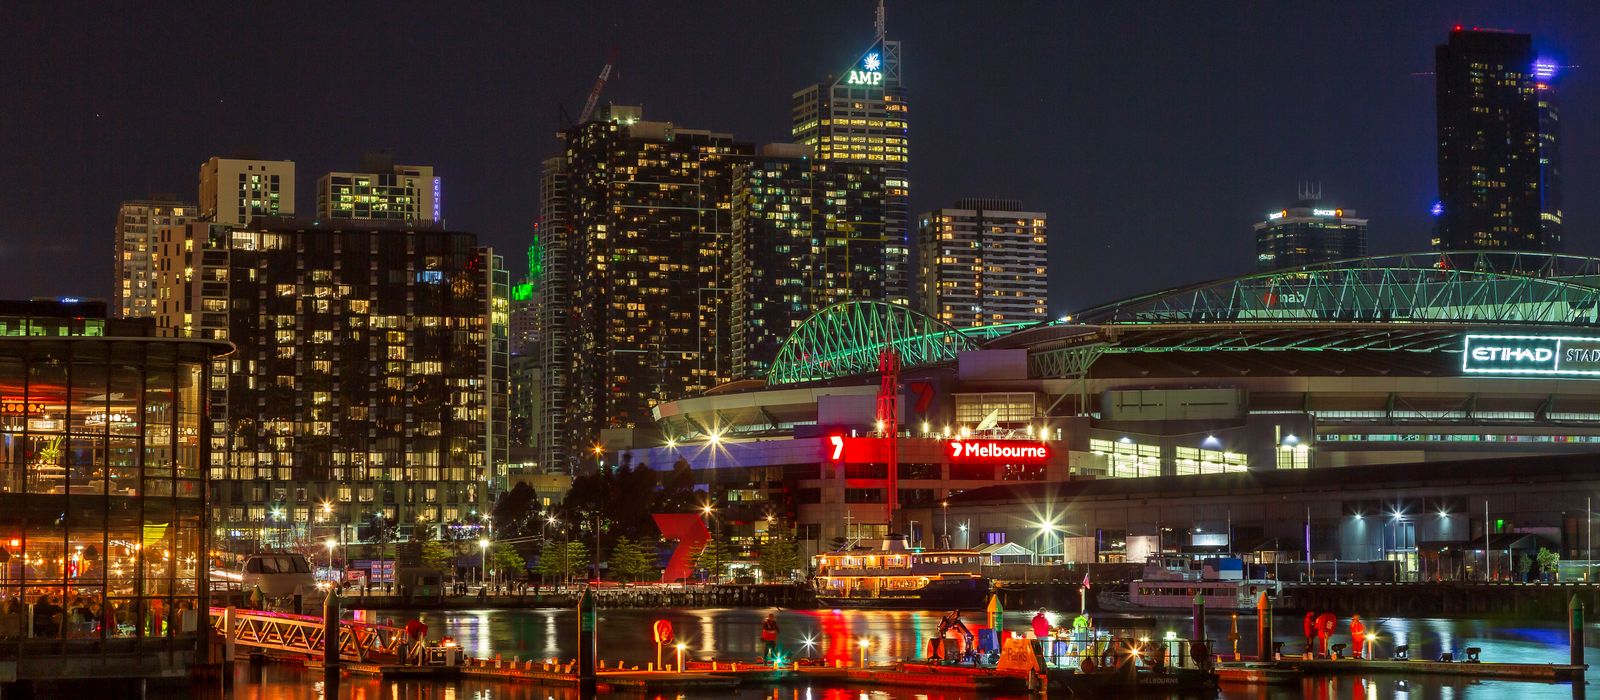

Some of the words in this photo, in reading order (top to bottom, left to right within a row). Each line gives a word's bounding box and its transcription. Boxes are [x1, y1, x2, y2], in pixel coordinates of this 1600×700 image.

[848, 70, 882, 85] AMP
[1279, 291, 1304, 303] nab
[1472, 347, 1552, 361] ETIHAD
[831, 436, 843, 459] 7
[951, 442, 963, 457] 7
[965, 442, 1046, 457] Melbourne
